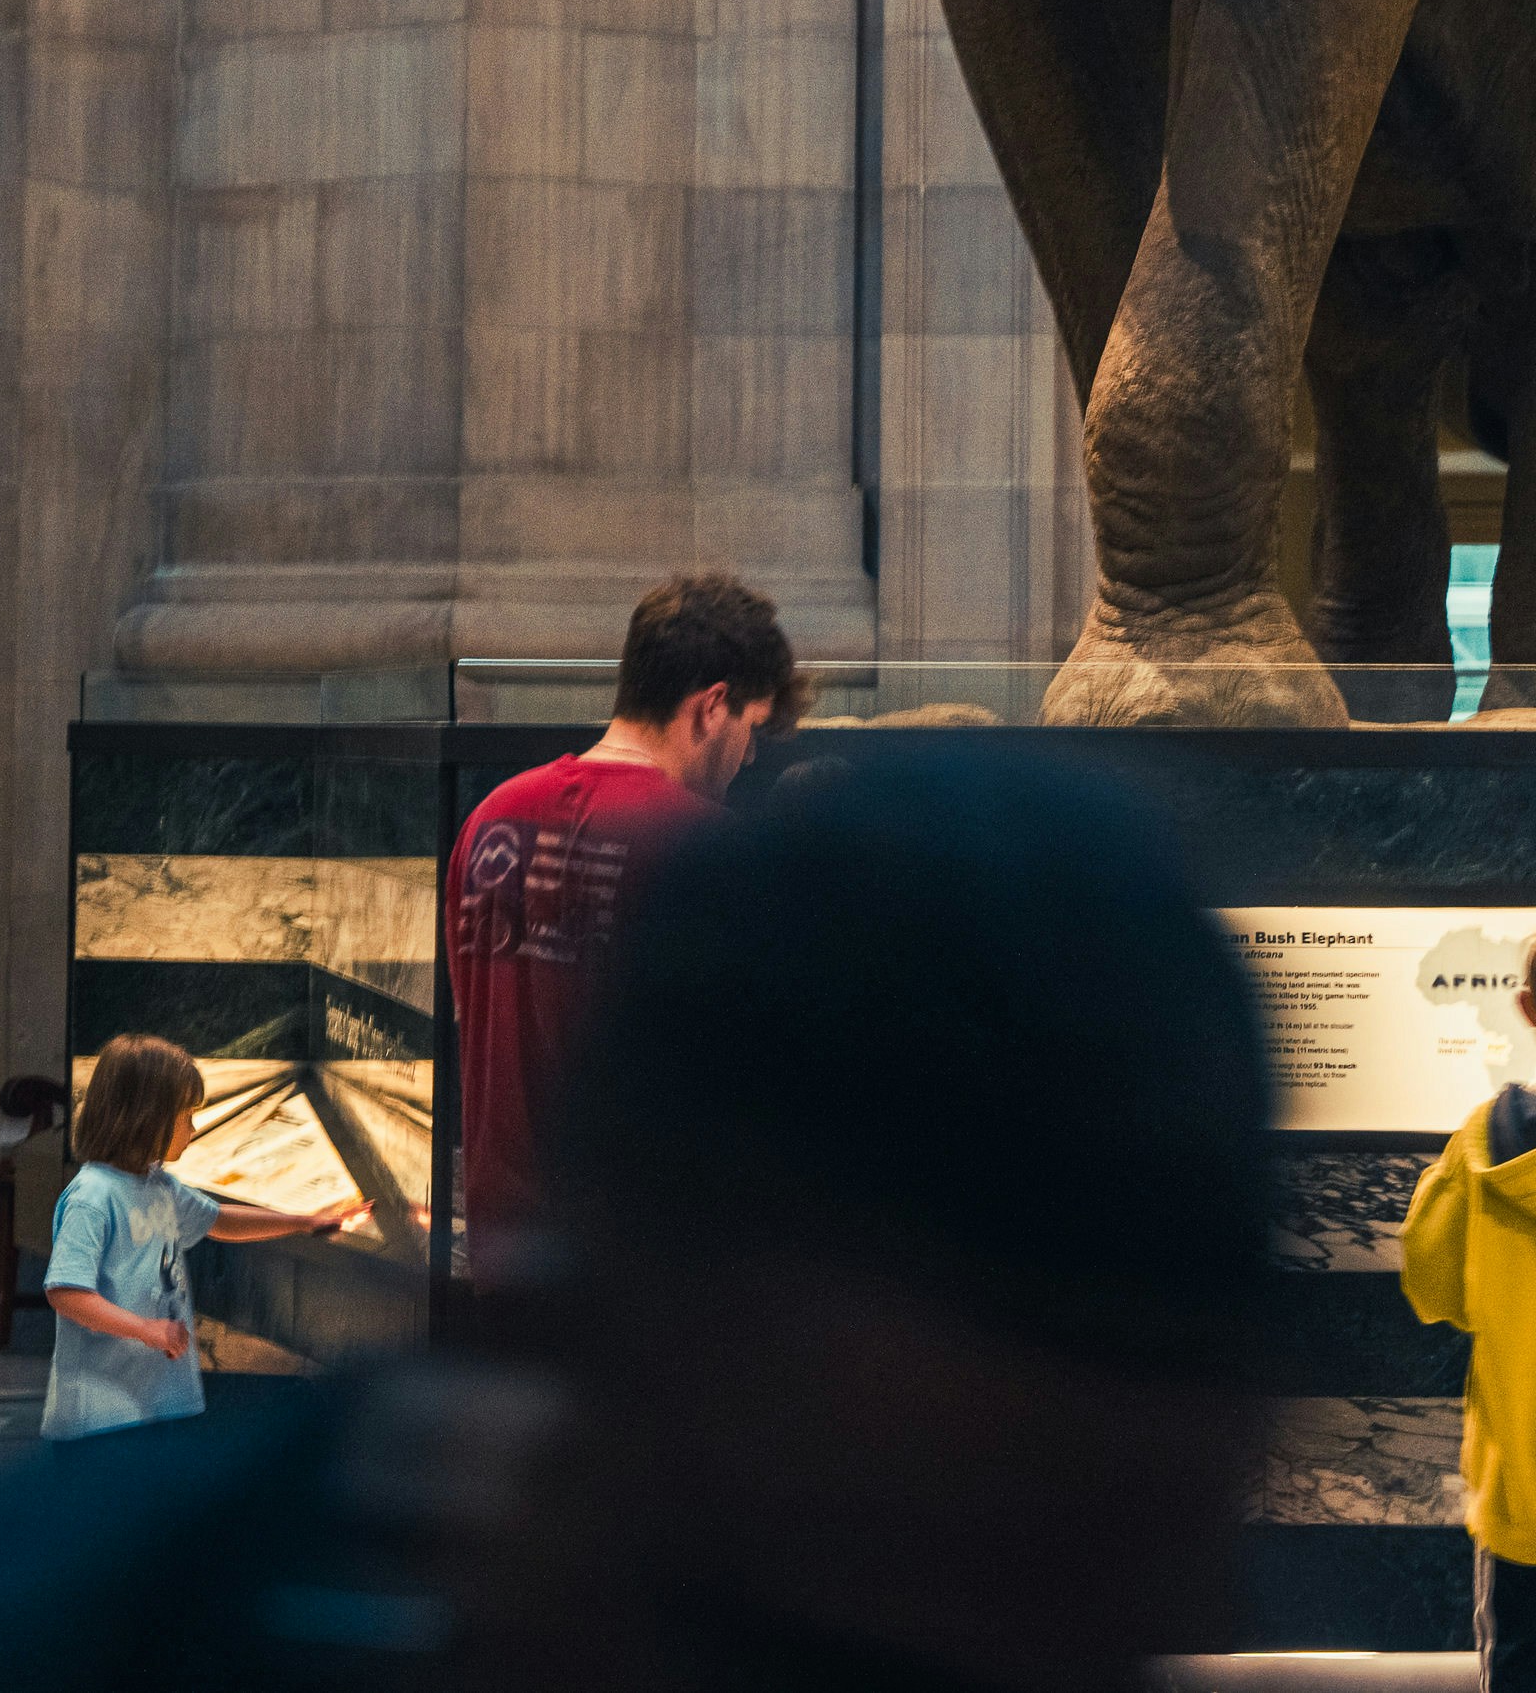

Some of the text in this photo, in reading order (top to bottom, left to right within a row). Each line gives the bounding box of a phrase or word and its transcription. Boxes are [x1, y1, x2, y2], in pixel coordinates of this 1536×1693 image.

[1255, 932, 1295, 944] Bush
[1301, 932, 1374, 947] Elephant
[1243, 949, 1284, 959] africana
[1271, 970, 1283, 978] the
[1285, 970, 1310, 980] largest
[1312, 970, 1343, 978] mounted
[1266, 981, 1287, 990] living
[1431, 974, 1519, 988] AFRIC
[1300, 992, 1309, 1001] by
[1311, 992, 1323, 1001] big
[1325, 993, 1345, 1001] game
